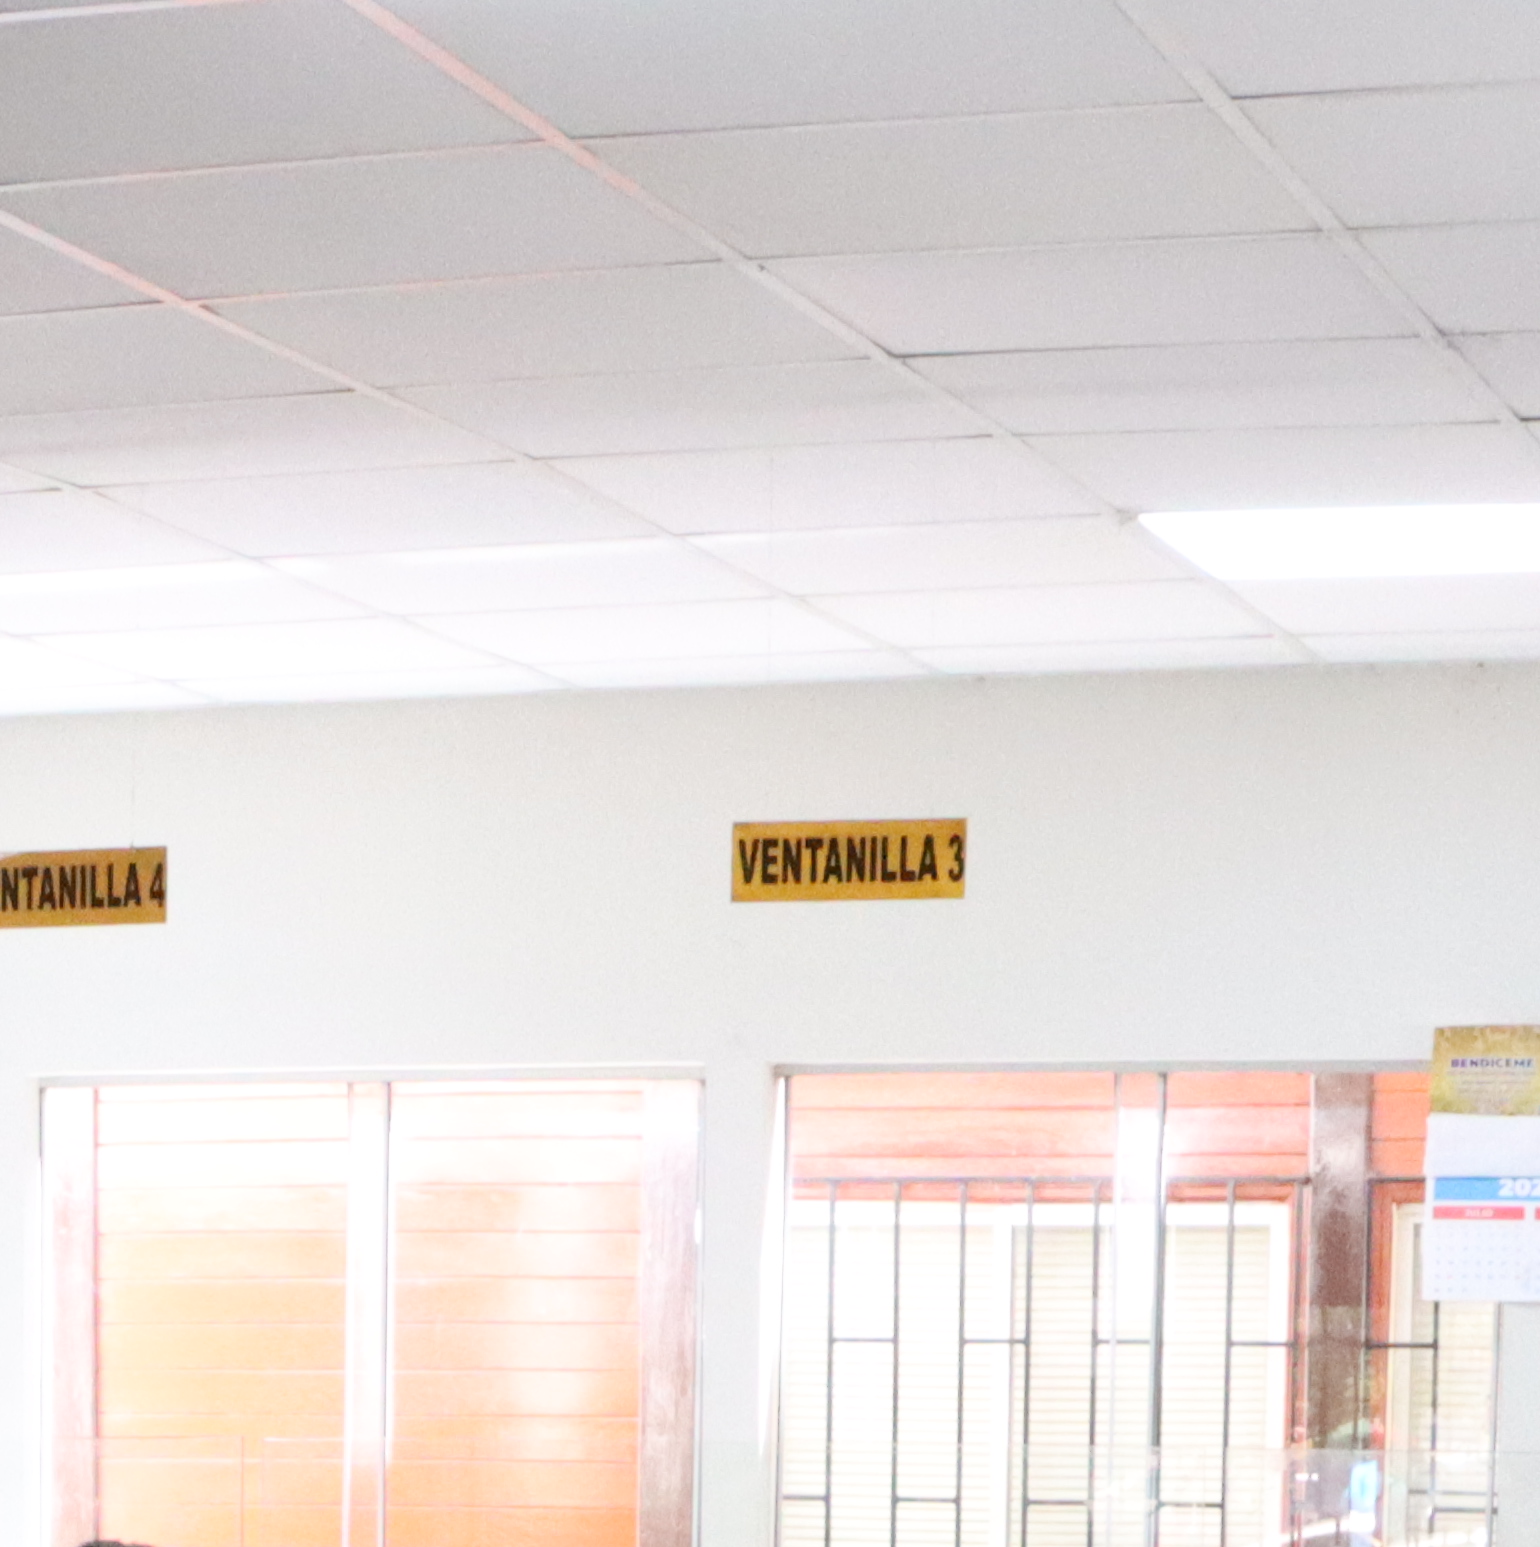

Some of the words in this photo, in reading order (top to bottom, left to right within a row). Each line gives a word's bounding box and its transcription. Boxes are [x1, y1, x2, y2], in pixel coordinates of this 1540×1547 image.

[738, 834, 938, 884] VENTANILLA
[948, 834, 965, 881] 3
[149, 861, 164, 908] 4
